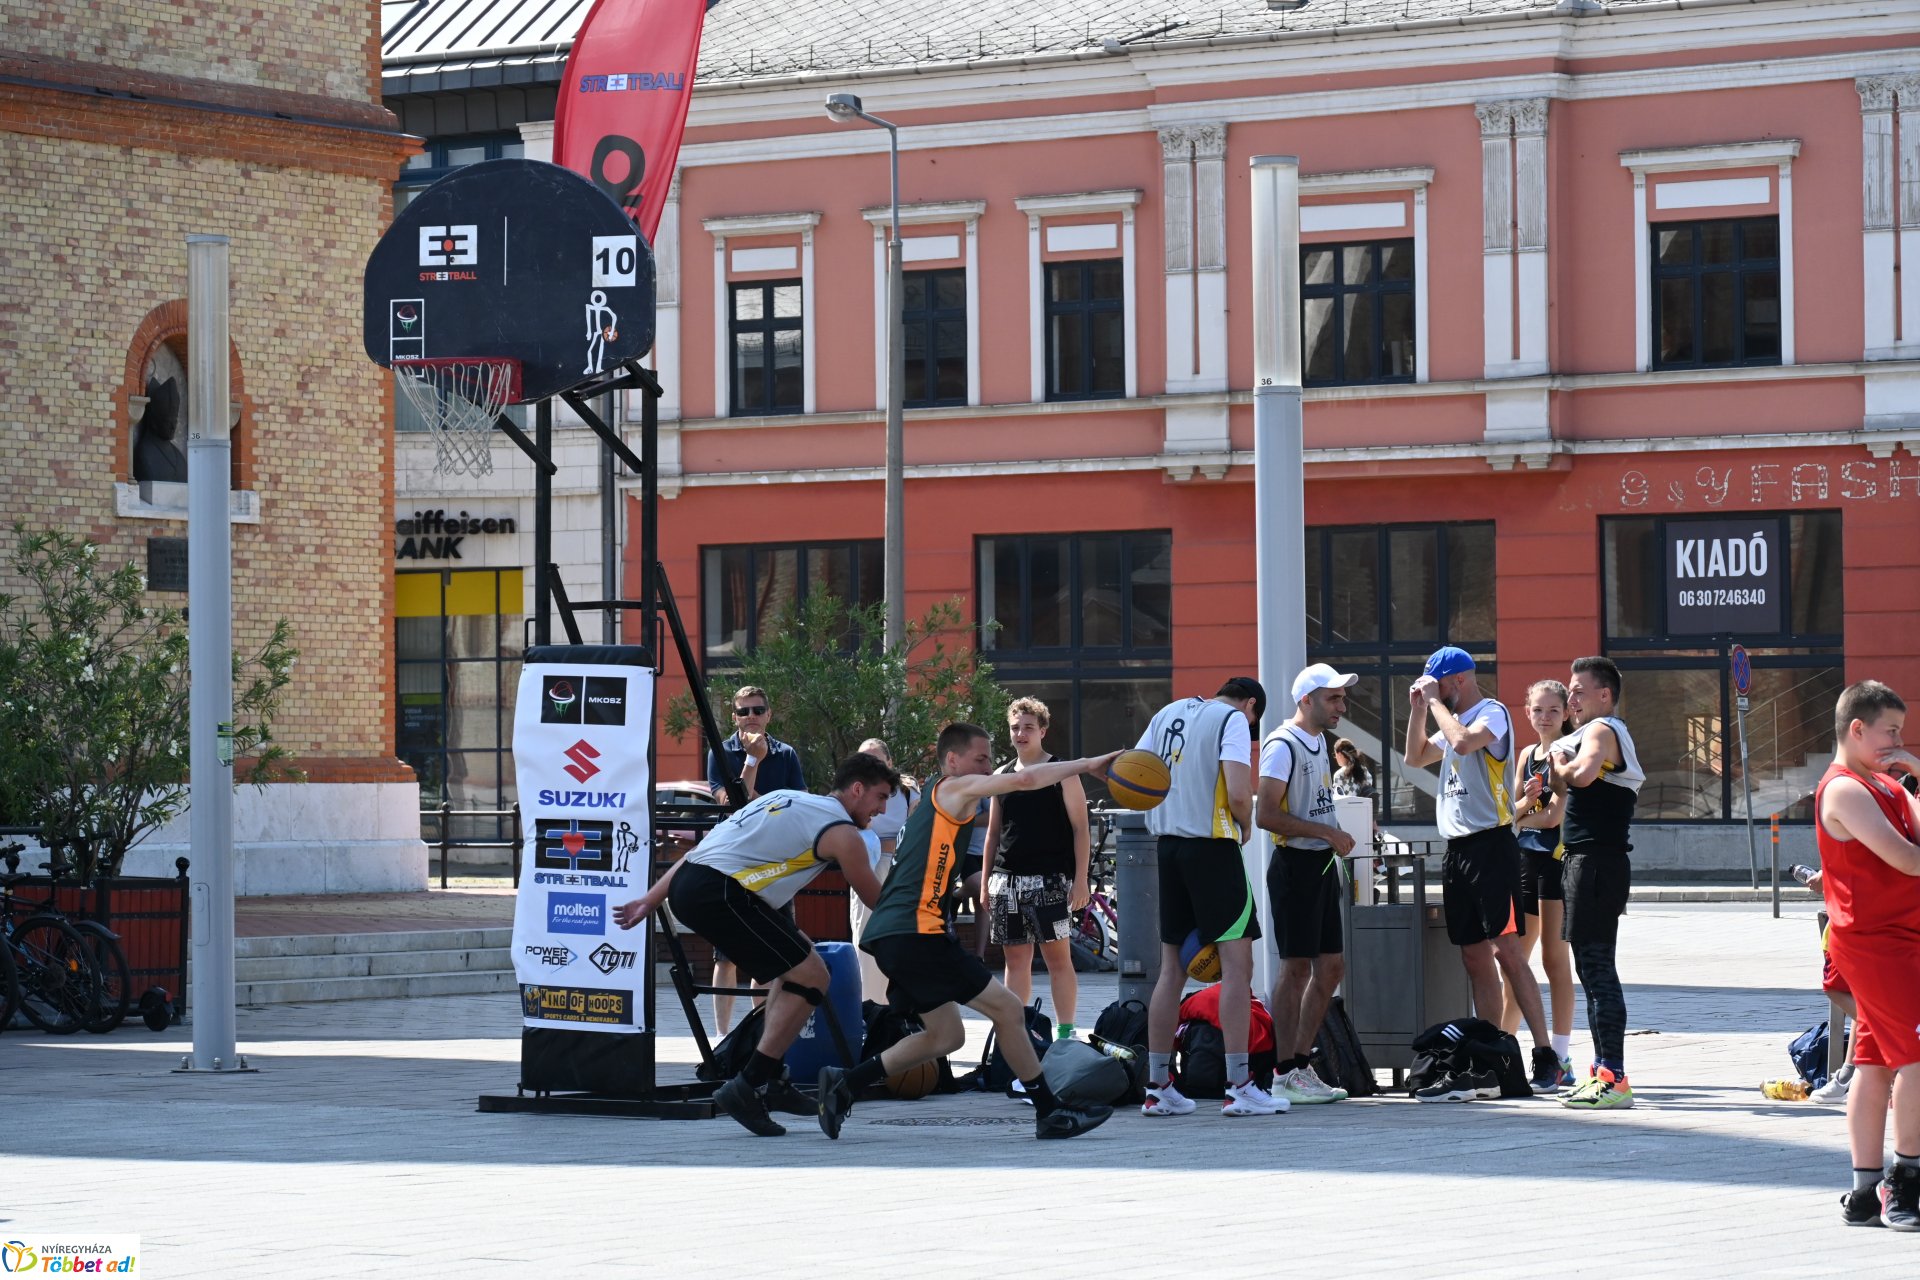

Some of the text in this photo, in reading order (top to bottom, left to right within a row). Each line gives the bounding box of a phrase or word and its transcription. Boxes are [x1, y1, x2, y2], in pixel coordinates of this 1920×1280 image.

[595, 247, 635, 275] 10
[419, 271, 477, 282] STREETBALL
[1261, 377, 1272, 386] 36
[191, 432, 201, 440] 36
[396, 509, 515, 535] aiffeisen
[395, 537, 464, 560] ANK
[1676, 530, 1768, 578] KIADÓ
[1679, 588, 1766, 607] 06 30 7246340
[588, 696, 622, 705] MKOSZ
[538, 789, 627, 808] SUZUKI
[534, 872, 628, 888] STREETBALL
[926, 843, 950, 910] STREETBALL
[554, 903, 600, 917] molten
[525, 946, 569, 957] POWER
[542, 956, 568, 966] ADE
[599, 950, 637, 969] TOTI
[541, 989, 566, 1007] KING
[571, 995, 584, 1008] OF
